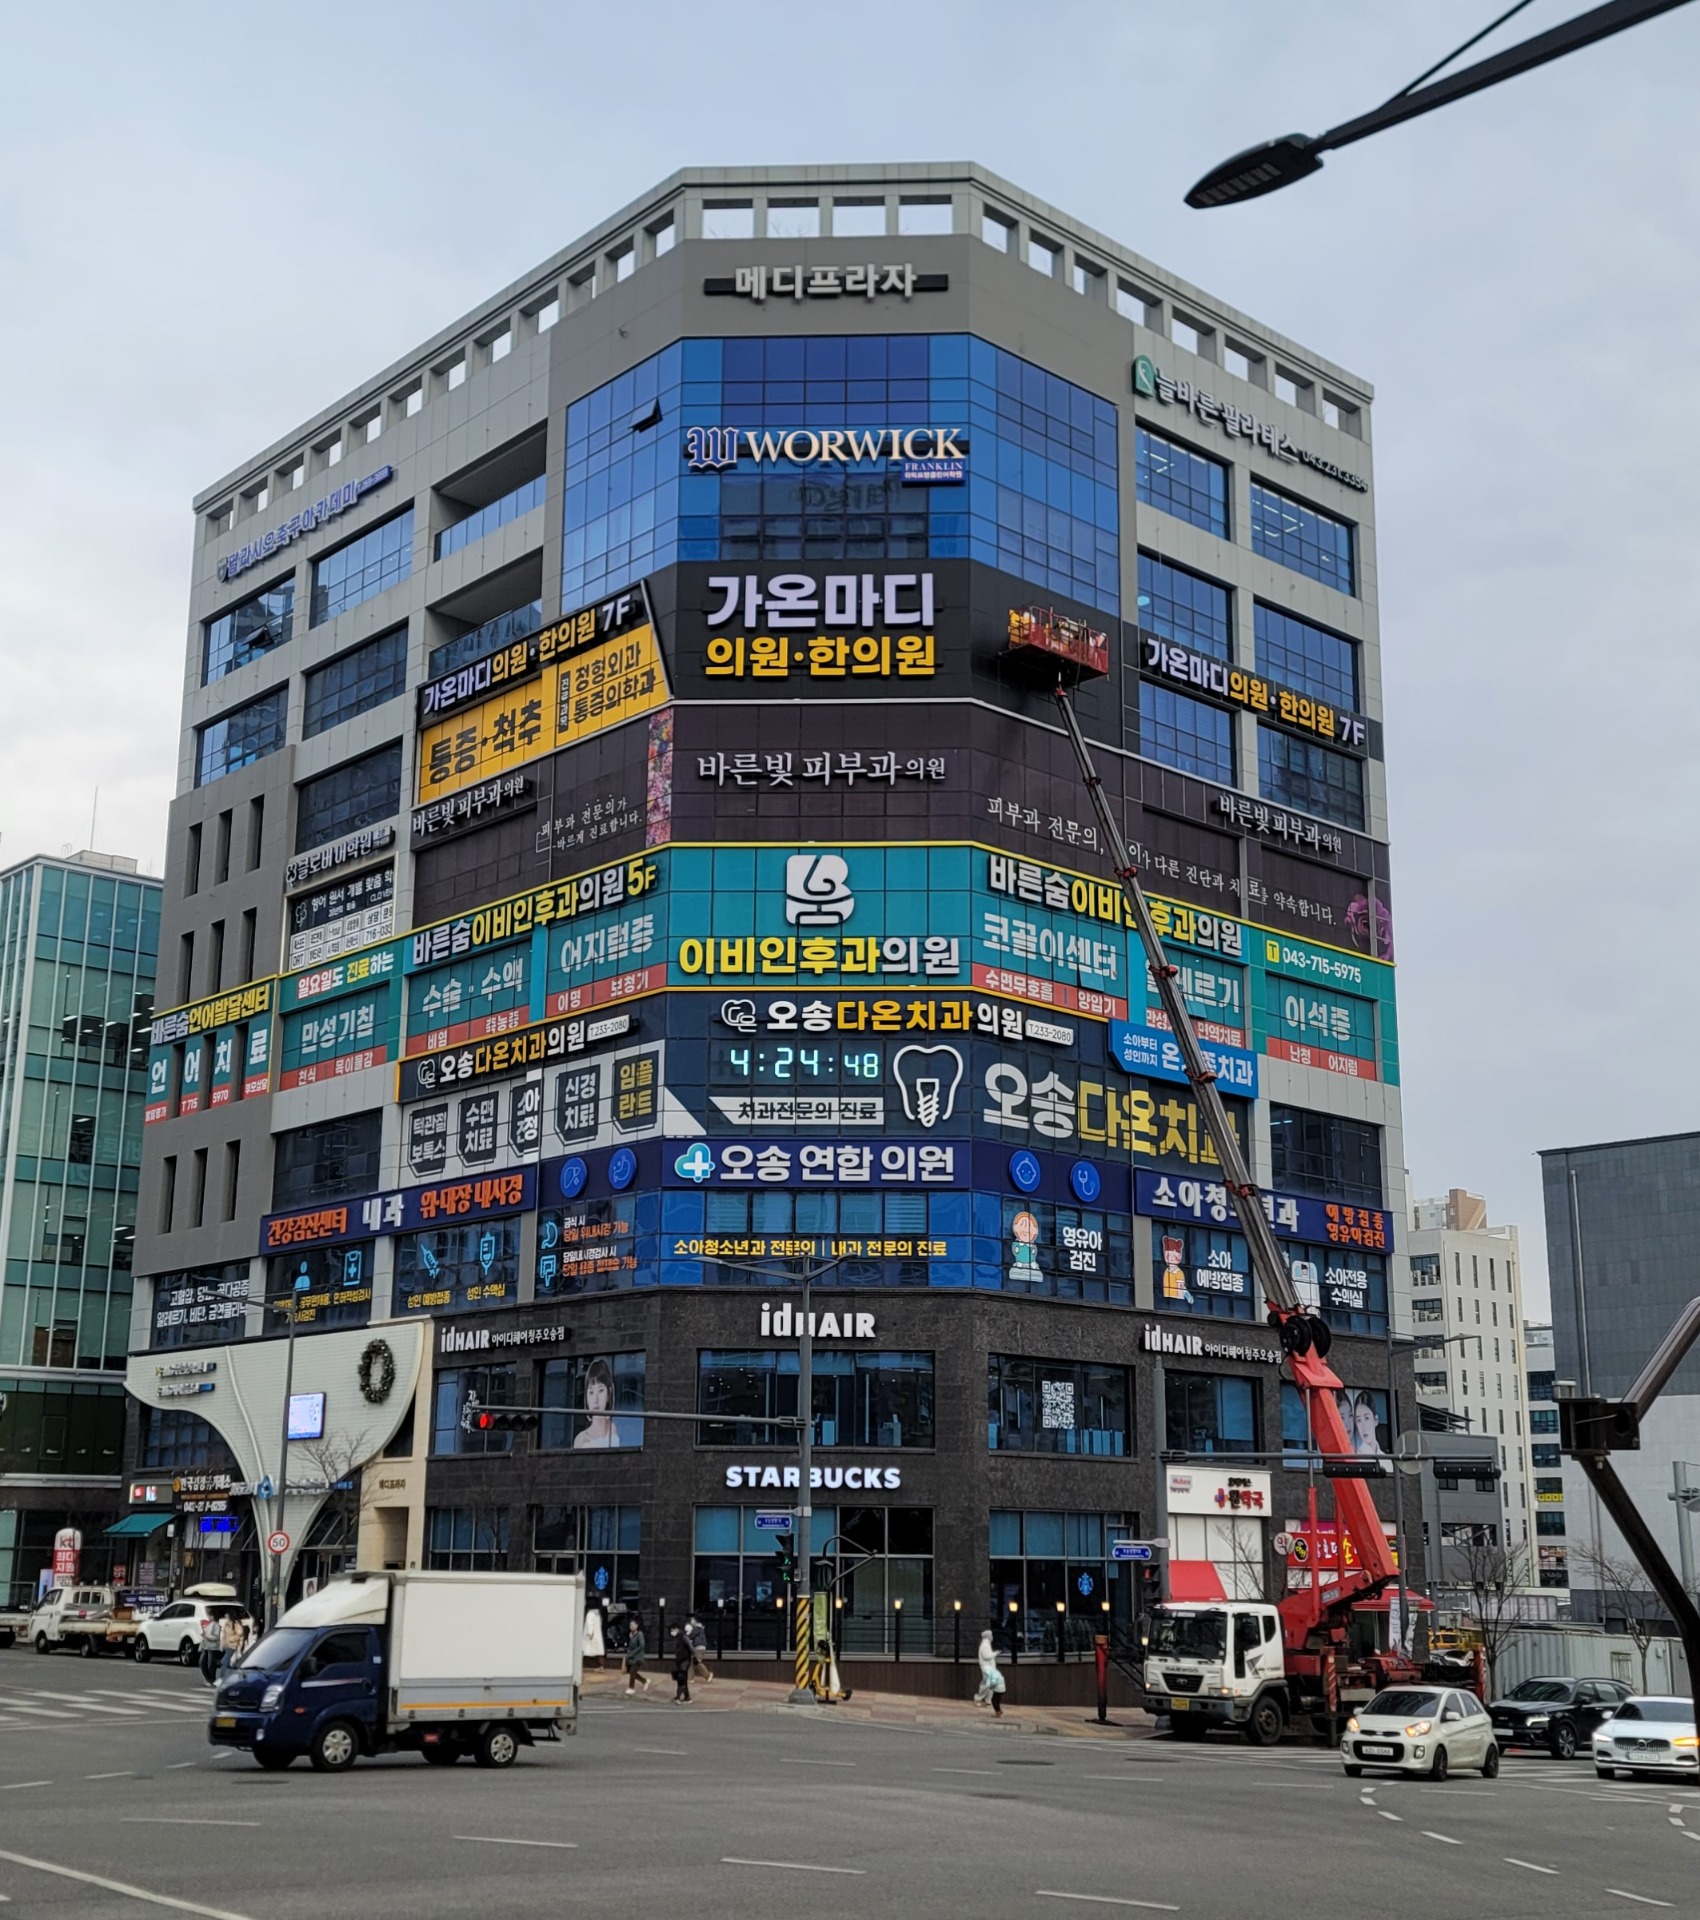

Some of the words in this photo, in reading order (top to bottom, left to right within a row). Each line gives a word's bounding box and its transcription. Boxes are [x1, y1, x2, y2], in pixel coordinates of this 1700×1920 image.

[734, 263, 918, 300] 메디프라자
[744, 428, 966, 463] WORWICK
[1221, 402, 1300, 463] 필라테스
[904, 461, 964, 471] FRANKLIN
[602, 594, 631, 632] 7F
[706, 573, 934, 628] 가온마디
[575, 640, 642, 693] 정형외과
[705, 635, 936, 676] 의원·한의원
[574, 668, 657, 724] 통증의학과
[1338, 715, 1366, 746] 7F
[698, 752, 794, 787] 바른빛
[801, 752, 946, 787] 피부과의원
[412, 800, 456, 837] 바른빛
[458, 775, 524, 821] 피부과의원
[541, 813, 575, 837] 피부과
[1219, 794, 1270, 835] 바른빛
[1272, 813, 1343, 855] 피부과의원
[297, 830, 373, 880] 클로버어학원
[987, 796, 1041, 836] 피부과
[1048, 815, 1104, 855] 전문의,
[1153, 855, 1181, 879] 다른
[1185, 866, 1225, 892] 진단과
[1229, 877, 1269, 903] 치료를
[1273, 891, 1337, 926] 약속합니다.
[413, 865, 625, 966] 바른숨이비인후과의원
[627, 858, 657, 897] 5F
[560, 913, 655, 974] 어지럼증
[678, 936, 961, 976] 이비인후과의원
[983, 911, 1118, 982] 코골이센터
[298, 965, 344, 1000] 일요일도
[346, 951, 395, 984] 진료하는
[1282, 947, 1362, 984] 043-715-5975
[422, 977, 463, 1018] 수술
[480, 957, 524, 1002] 수액
[557, 987, 581, 1012] 이명
[610, 971, 649, 998] 보청기
[985, 968, 1054, 1003] 수면무호흡
[1077, 989, 1117, 1018] 양압기
[151, 983, 271, 1046] 바른숨언어발달센터
[301, 1003, 375, 1055] 만성기침
[767, 1000, 1024, 1041] 오송다온치과의원
[1284, 995, 1351, 1042] 이석증
[427, 1029, 448, 1051] 비염
[1123, 1032, 1158, 1051] 소아부터
[1197, 1021, 1242, 1048] 면역치료
[151, 1058, 168, 1095] 언
[184, 1049, 200, 1084] 어
[215, 1039, 231, 1076] 치
[249, 1028, 268, 1066] 료
[439, 1020, 585, 1084] 오송다온치과의원
[730, 1047, 879, 1078] 4:24:48
[1123, 1048, 1158, 1068] 성인까지
[1289, 1044, 1312, 1065] 난청
[1328, 1054, 1358, 1078] 어지럼
[297, 1066, 317, 1086] 천식
[334, 1051, 374, 1077] 목이물감
[619, 1058, 654, 1091] 임플
[212, 1088, 229, 1104] 5970
[565, 1072, 597, 1101] 신경
[465, 1097, 495, 1128] 수면
[564, 1102, 596, 1132] 치료
[618, 1089, 654, 1121] 란트
[738, 1101, 833, 1121] 치과전문의
[839, 1101, 877, 1121] 진료
[412, 1140, 446, 1164] 보톡스
[464, 1130, 493, 1156] 치료
[719, 1145, 792, 1182] 오송
[799, 1145, 874, 1182] 연합
[881, 1145, 954, 1182] 의원
[267, 1207, 348, 1247] 건강검진센터
[363, 1193, 404, 1232] 내과
[563, 1216, 578, 1229] 금식
[563, 1228, 578, 1242] 당일
[581, 1223, 613, 1240] 위내시경
[673, 1239, 766, 1257] 소아청소년과
[769, 1240, 816, 1257] 전문의
[831, 1240, 863, 1257] 내과
[866, 1240, 913, 1257] 전문의
[916, 1240, 947, 1257] 진료
[1062, 1226, 1103, 1250] 영유아
[1326, 1223, 1386, 1249] 영유아검진
[1069, 1250, 1097, 1272] 검진
[1207, 1249, 1232, 1270] 소아
[466, 1286, 482, 1300] 성인
[1196, 1267, 1245, 1293] 예방접종
[1324, 1265, 1368, 1290] 소아전용
[407, 1292, 422, 1308] 성인
[1330, 1289, 1364, 1309] 수액실
[491, 1326, 565, 1347] 아이디헤어청주오송점
[725, 1466, 901, 1489] STARBUCKS
[55, 1551, 75, 1562] 최대
[59, 1535, 75, 1549] kt
[272, 1537, 285, 1548] 50
[55, 1562, 75, 1573] 지원
